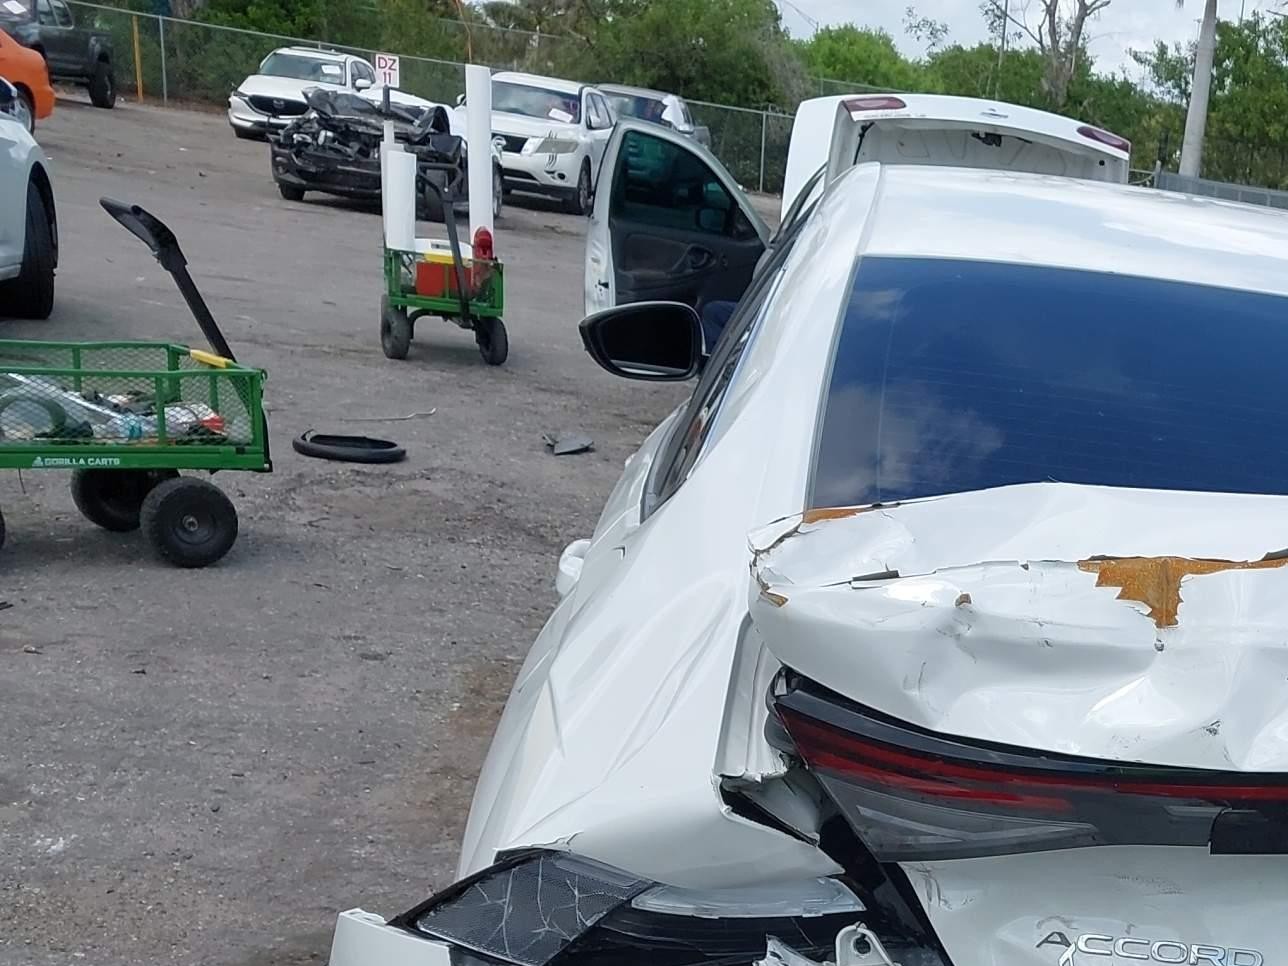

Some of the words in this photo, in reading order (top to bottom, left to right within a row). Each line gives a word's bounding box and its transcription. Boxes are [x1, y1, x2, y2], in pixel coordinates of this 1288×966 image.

[378, 56, 397, 71] DZ
[383, 71, 391, 85] 11
[44, 457, 85, 466] GORILLA
